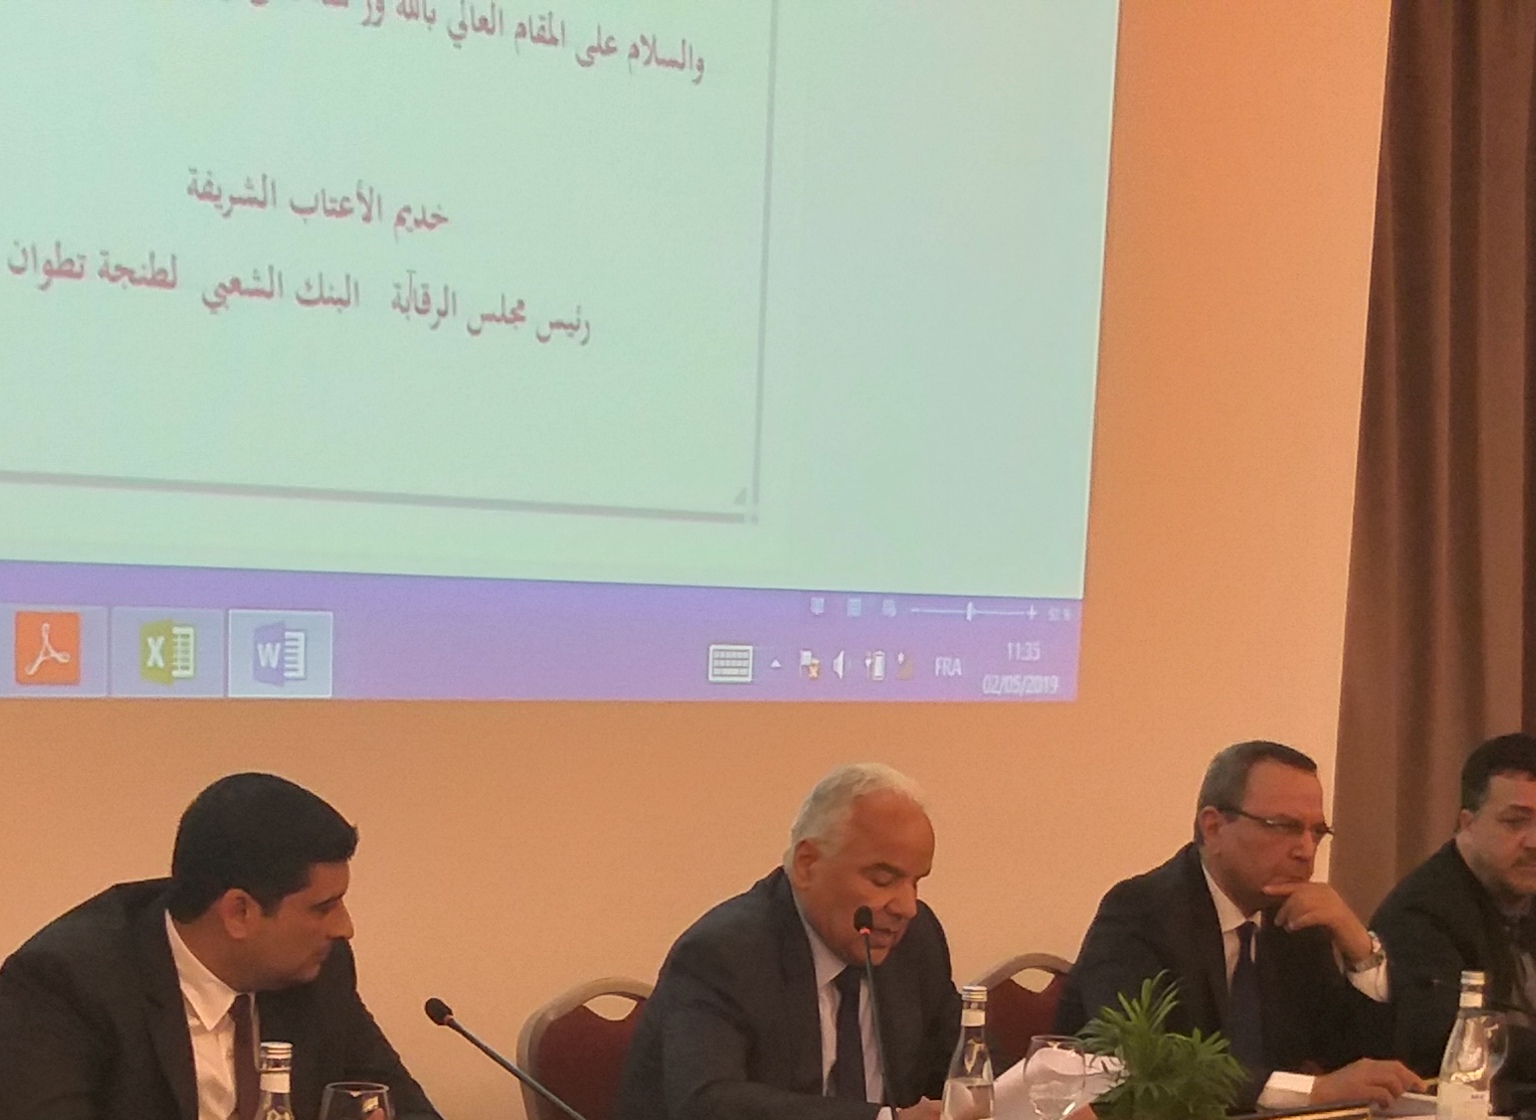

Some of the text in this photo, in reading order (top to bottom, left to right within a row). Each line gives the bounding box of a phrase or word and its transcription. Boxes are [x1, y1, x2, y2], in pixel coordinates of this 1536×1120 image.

[514, 11, 566, 54] المقام
[575, 25, 619, 68] على
[627, 34, 705, 85] والسلام
[186, 168, 450, 243] خديم الأعتاب الشريفة
[7, 241, 88, 292] تطوان
[97, 251, 178, 291] لطنجة
[201, 265, 284, 315] الشعبي
[295, 273, 360, 309] البنك
[466, 294, 527, 337] مجلس
[535, 305, 592, 347] رئيس
[935, 657, 962, 677] FRA
[982, 674, 1059, 696] 02/05/2019
